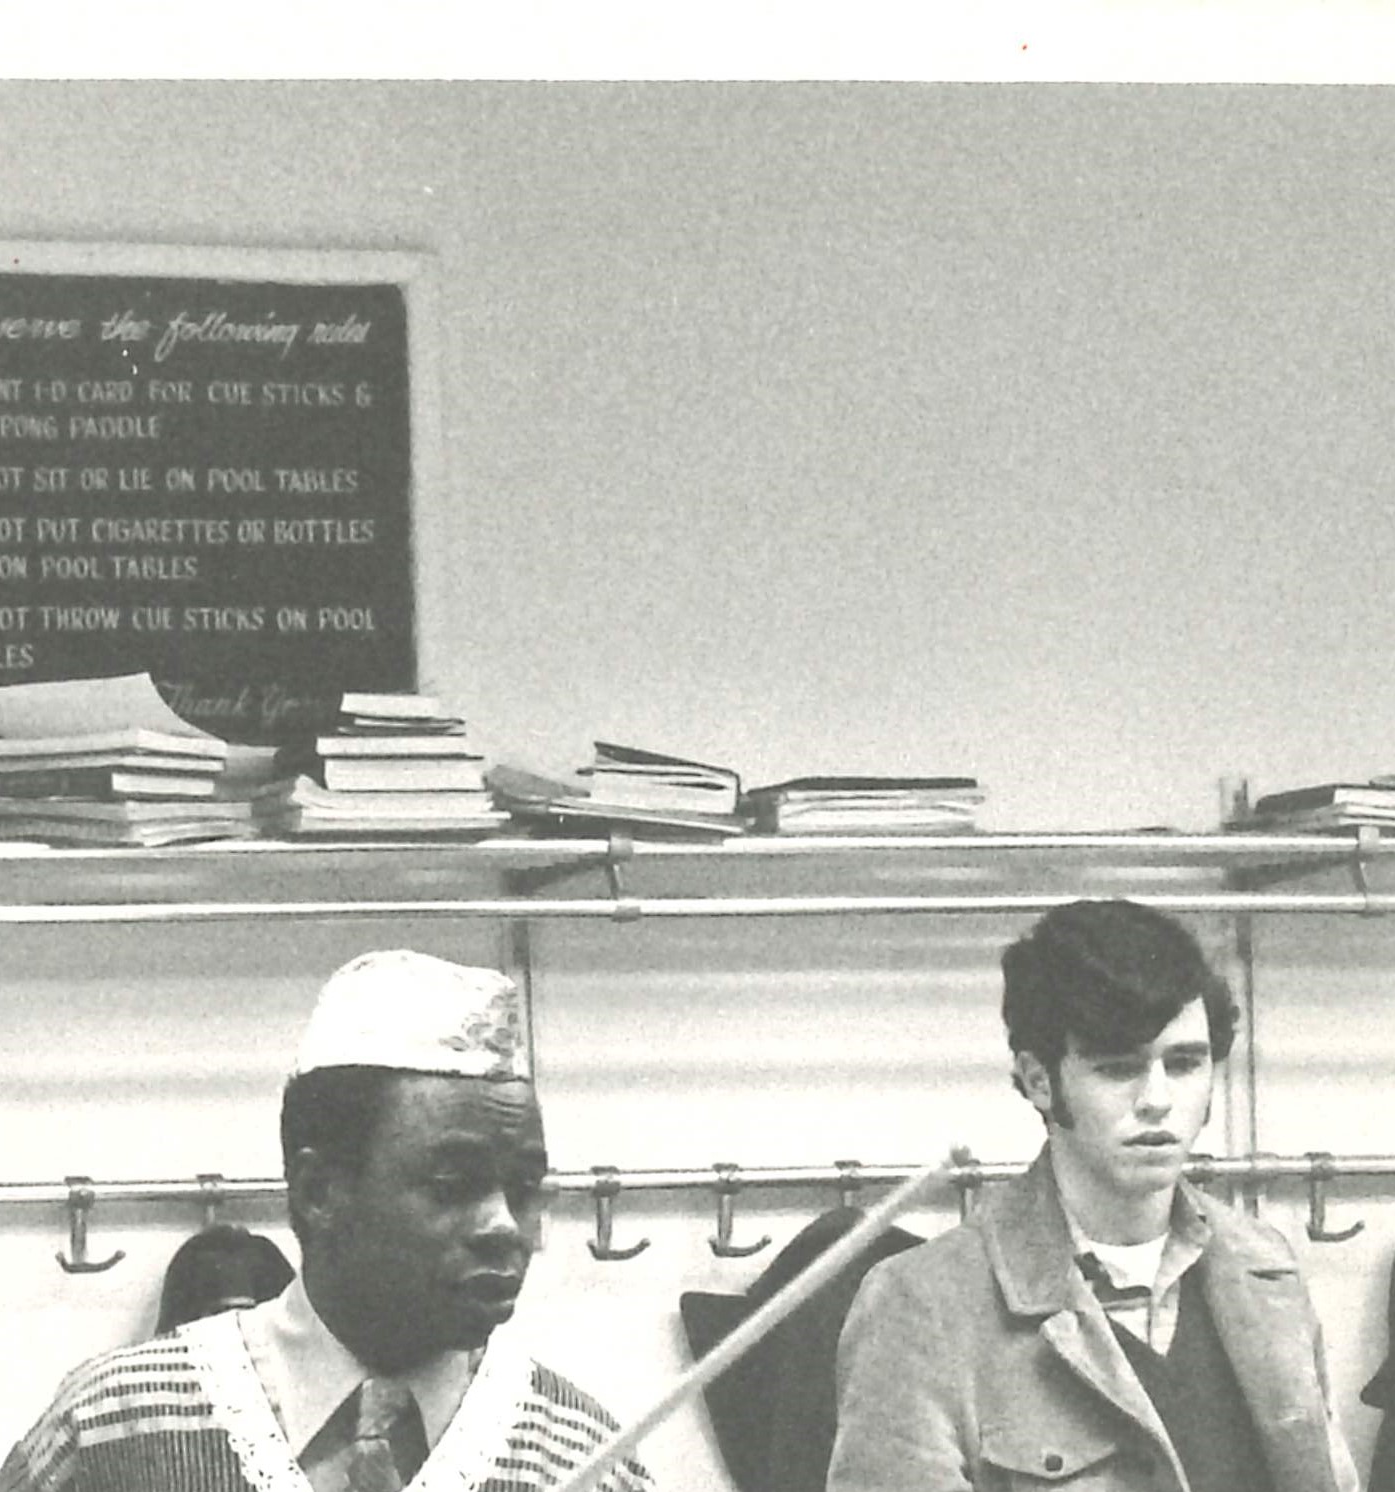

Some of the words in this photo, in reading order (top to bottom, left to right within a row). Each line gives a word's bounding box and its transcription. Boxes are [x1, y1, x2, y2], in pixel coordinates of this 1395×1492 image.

[100, 309, 151, 342] the
[153, 310, 301, 363] following
[76, 380, 134, 403] CARD
[148, 379, 193, 403] FOR
[207, 380, 251, 405] CUE
[261, 381, 345, 406] STICKS
[354, 381, 373, 408] &
[0, 414, 58, 440] PONG
[69, 415, 158, 439] PADDLE
[33, 466, 69, 492] SIT
[79, 467, 109, 491] OR
[118, 467, 152, 491] LIE
[166, 468, 196, 491] ON
[207, 467, 266, 493] POOL
[274, 468, 358, 493] TABLES
[36, 517, 80, 543] PUT
[90, 517, 230, 544] CIGARETTES
[236, 519, 266, 544] OR
[273, 518, 375, 545] BOTTLES
[40, 555, 101, 580] POOL
[111, 555, 197, 580] TABLES
[40, 606, 121, 630] THROW
[131, 607, 172, 631] CUE
[183, 606, 265, 631] STICKS
[276, 607, 307, 632] ON
[318, 606, 376, 631] POOL
[159, 682, 250, 718] Thank
